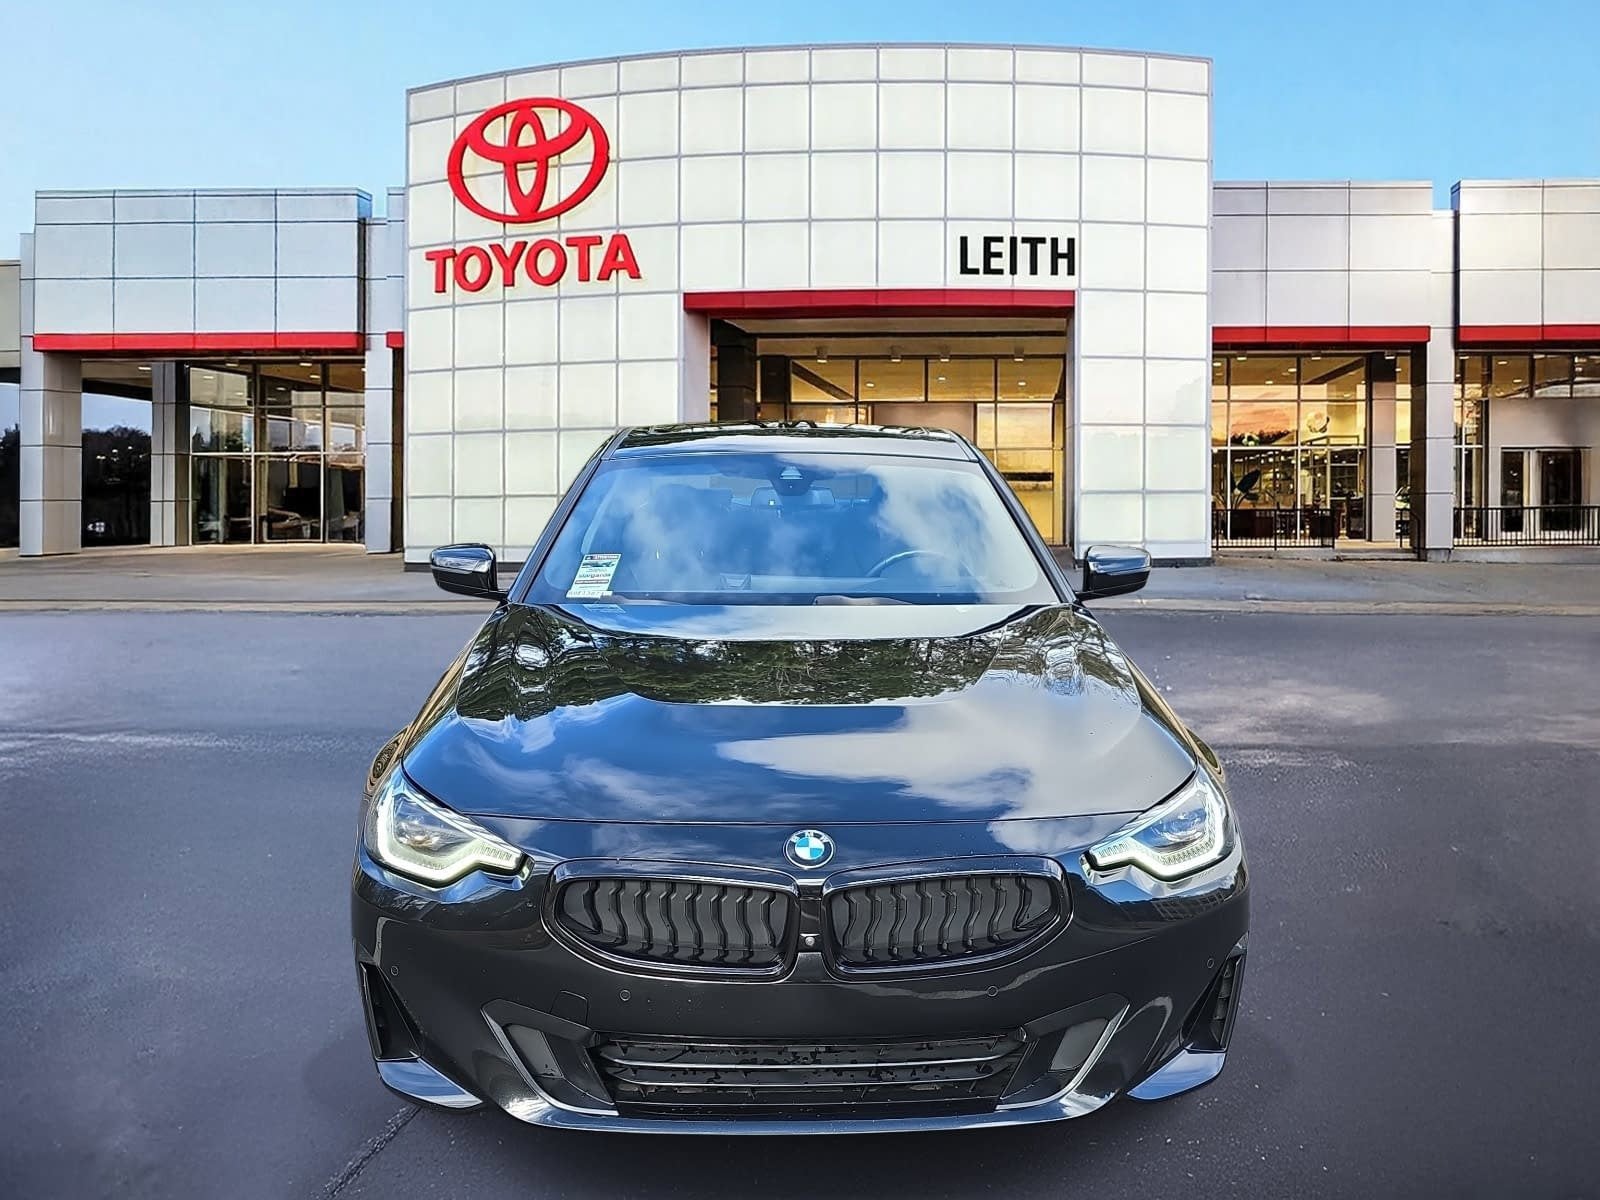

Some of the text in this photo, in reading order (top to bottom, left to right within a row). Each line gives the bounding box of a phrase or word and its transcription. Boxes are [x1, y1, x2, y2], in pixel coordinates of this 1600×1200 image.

[425, 234, 641, 293] TOYOTA
[960, 236, 1075, 275] LEITH
[790, 831, 830, 843] BMW
